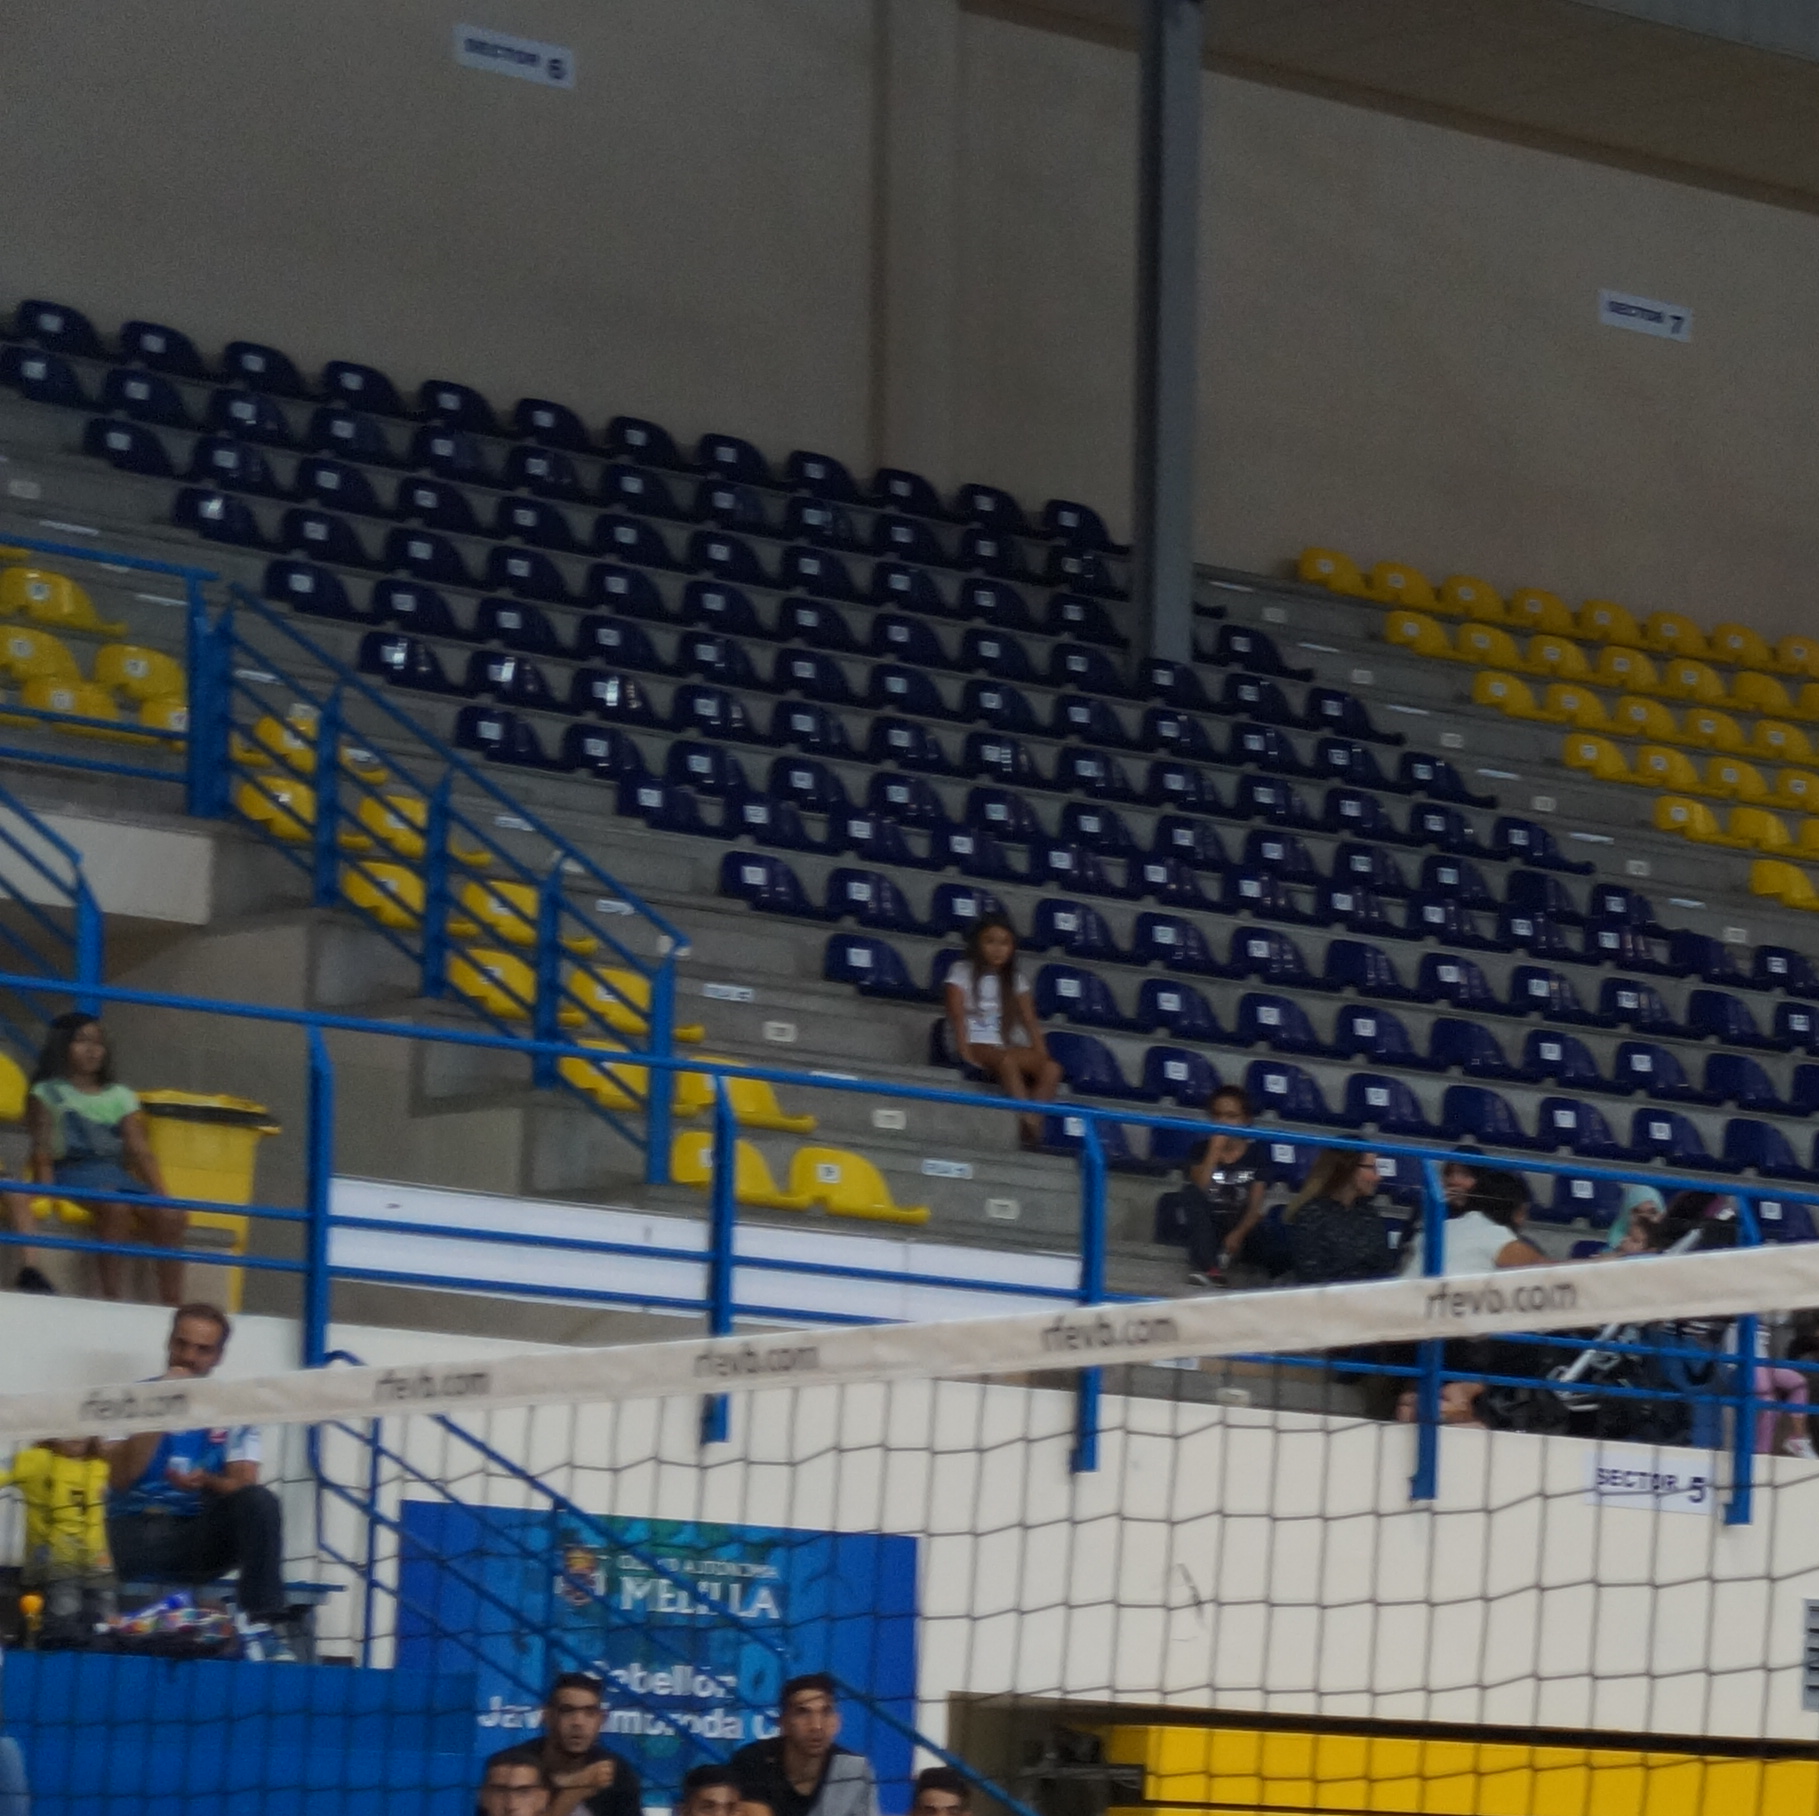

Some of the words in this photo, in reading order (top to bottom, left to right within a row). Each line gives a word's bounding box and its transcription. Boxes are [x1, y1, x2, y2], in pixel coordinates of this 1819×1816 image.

[1669, 314, 1684, 334] 7
[1425, 1282, 1577, 1320] rfevb.com
[1597, 1467, 1677, 1491] SECTOR
[1687, 1475, 1706, 1503] 5
